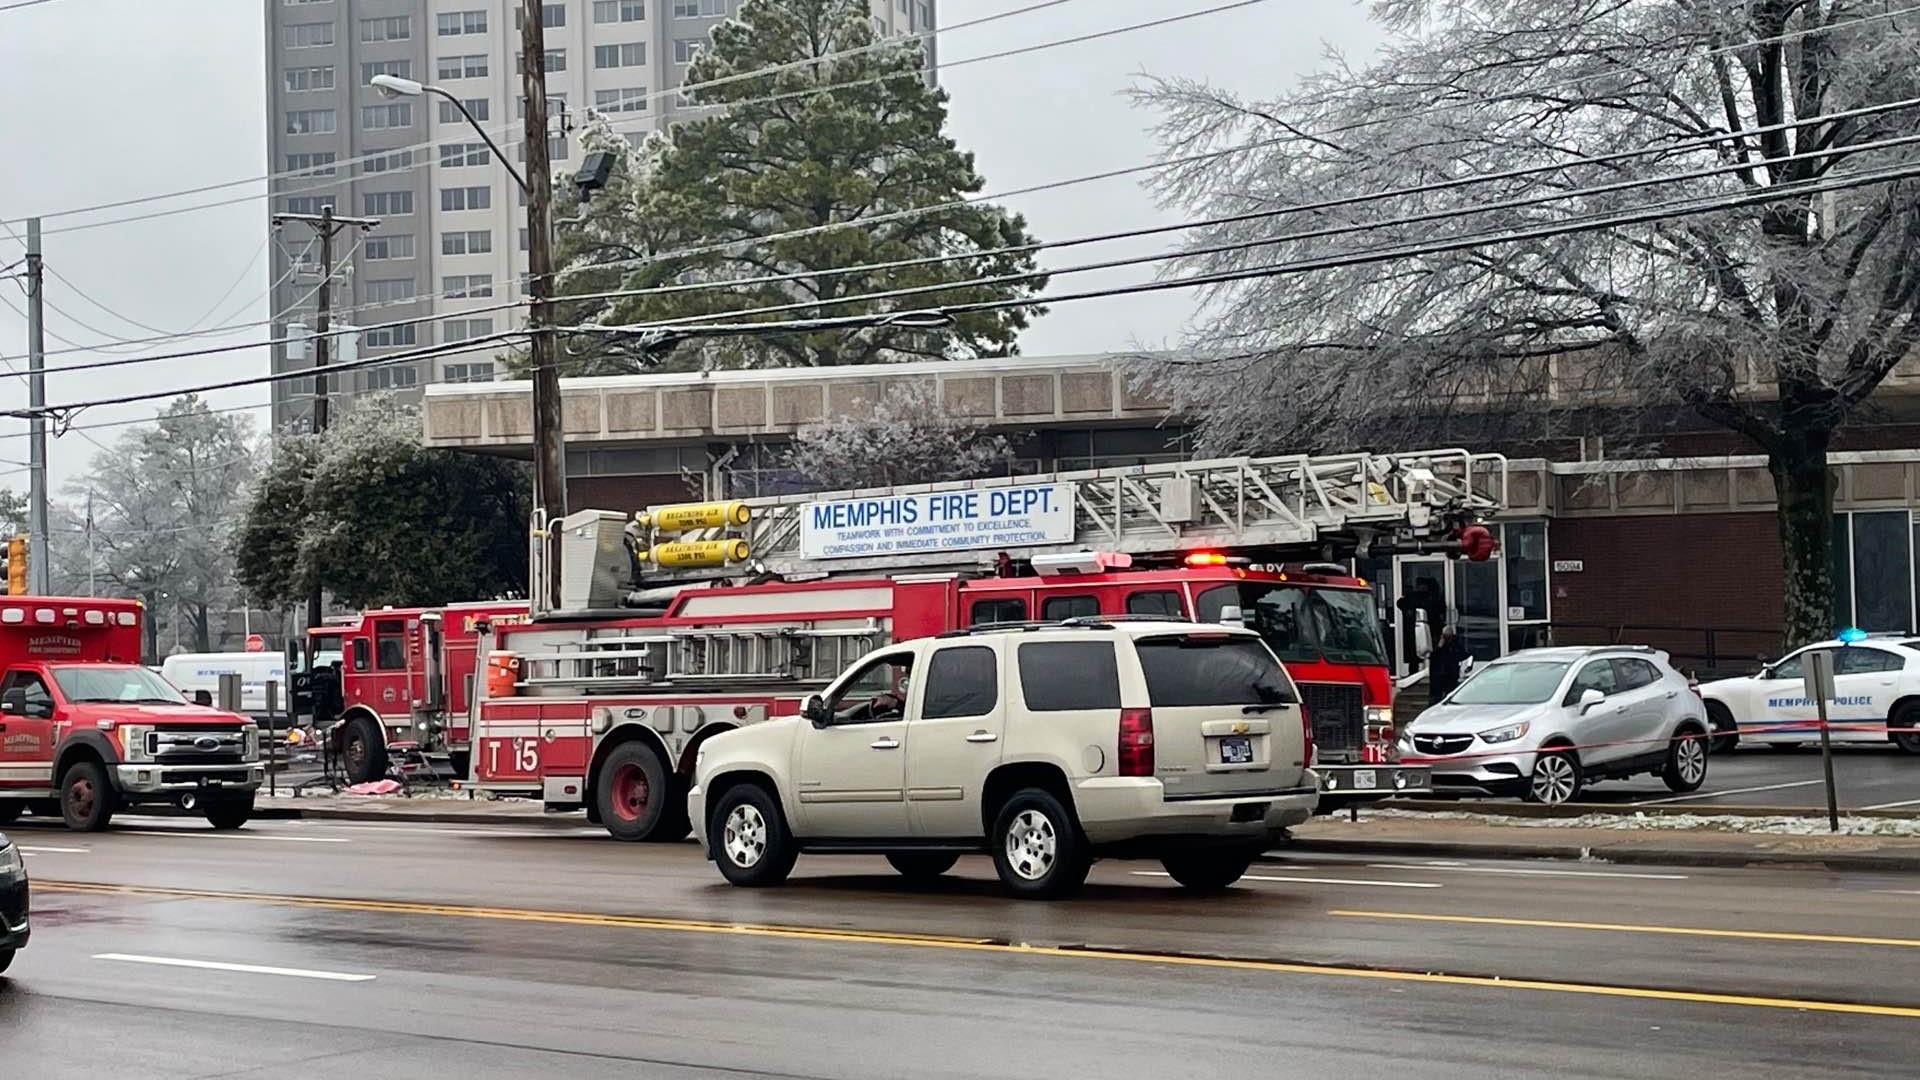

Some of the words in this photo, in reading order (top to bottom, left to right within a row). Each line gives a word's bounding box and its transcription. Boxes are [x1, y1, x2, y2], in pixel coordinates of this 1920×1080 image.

[814, 498, 918, 530] MEMPHIS
[929, 493, 978, 521] FIRE
[991, 488, 1059, 516] DEPT.
[838, 529, 881, 541] TEAMWORK
[884, 528, 904, 538] WITH
[906, 522, 960, 536] COMMITMENT
[963, 522, 974, 532] TO
[706, 542, 717, 550] AIR
[823, 542, 874, 555] COMPASSION
[876, 540, 893, 551] AND
[896, 538, 938, 549] IMMEDIATE
[941, 535, 990, 547] COMMUNITY
[29, 635, 81, 646] MEMPHIS
[1833, 696, 1872, 705] POLICE
[489, 741, 501, 772] T
[514, 740, 538, 772] 15
